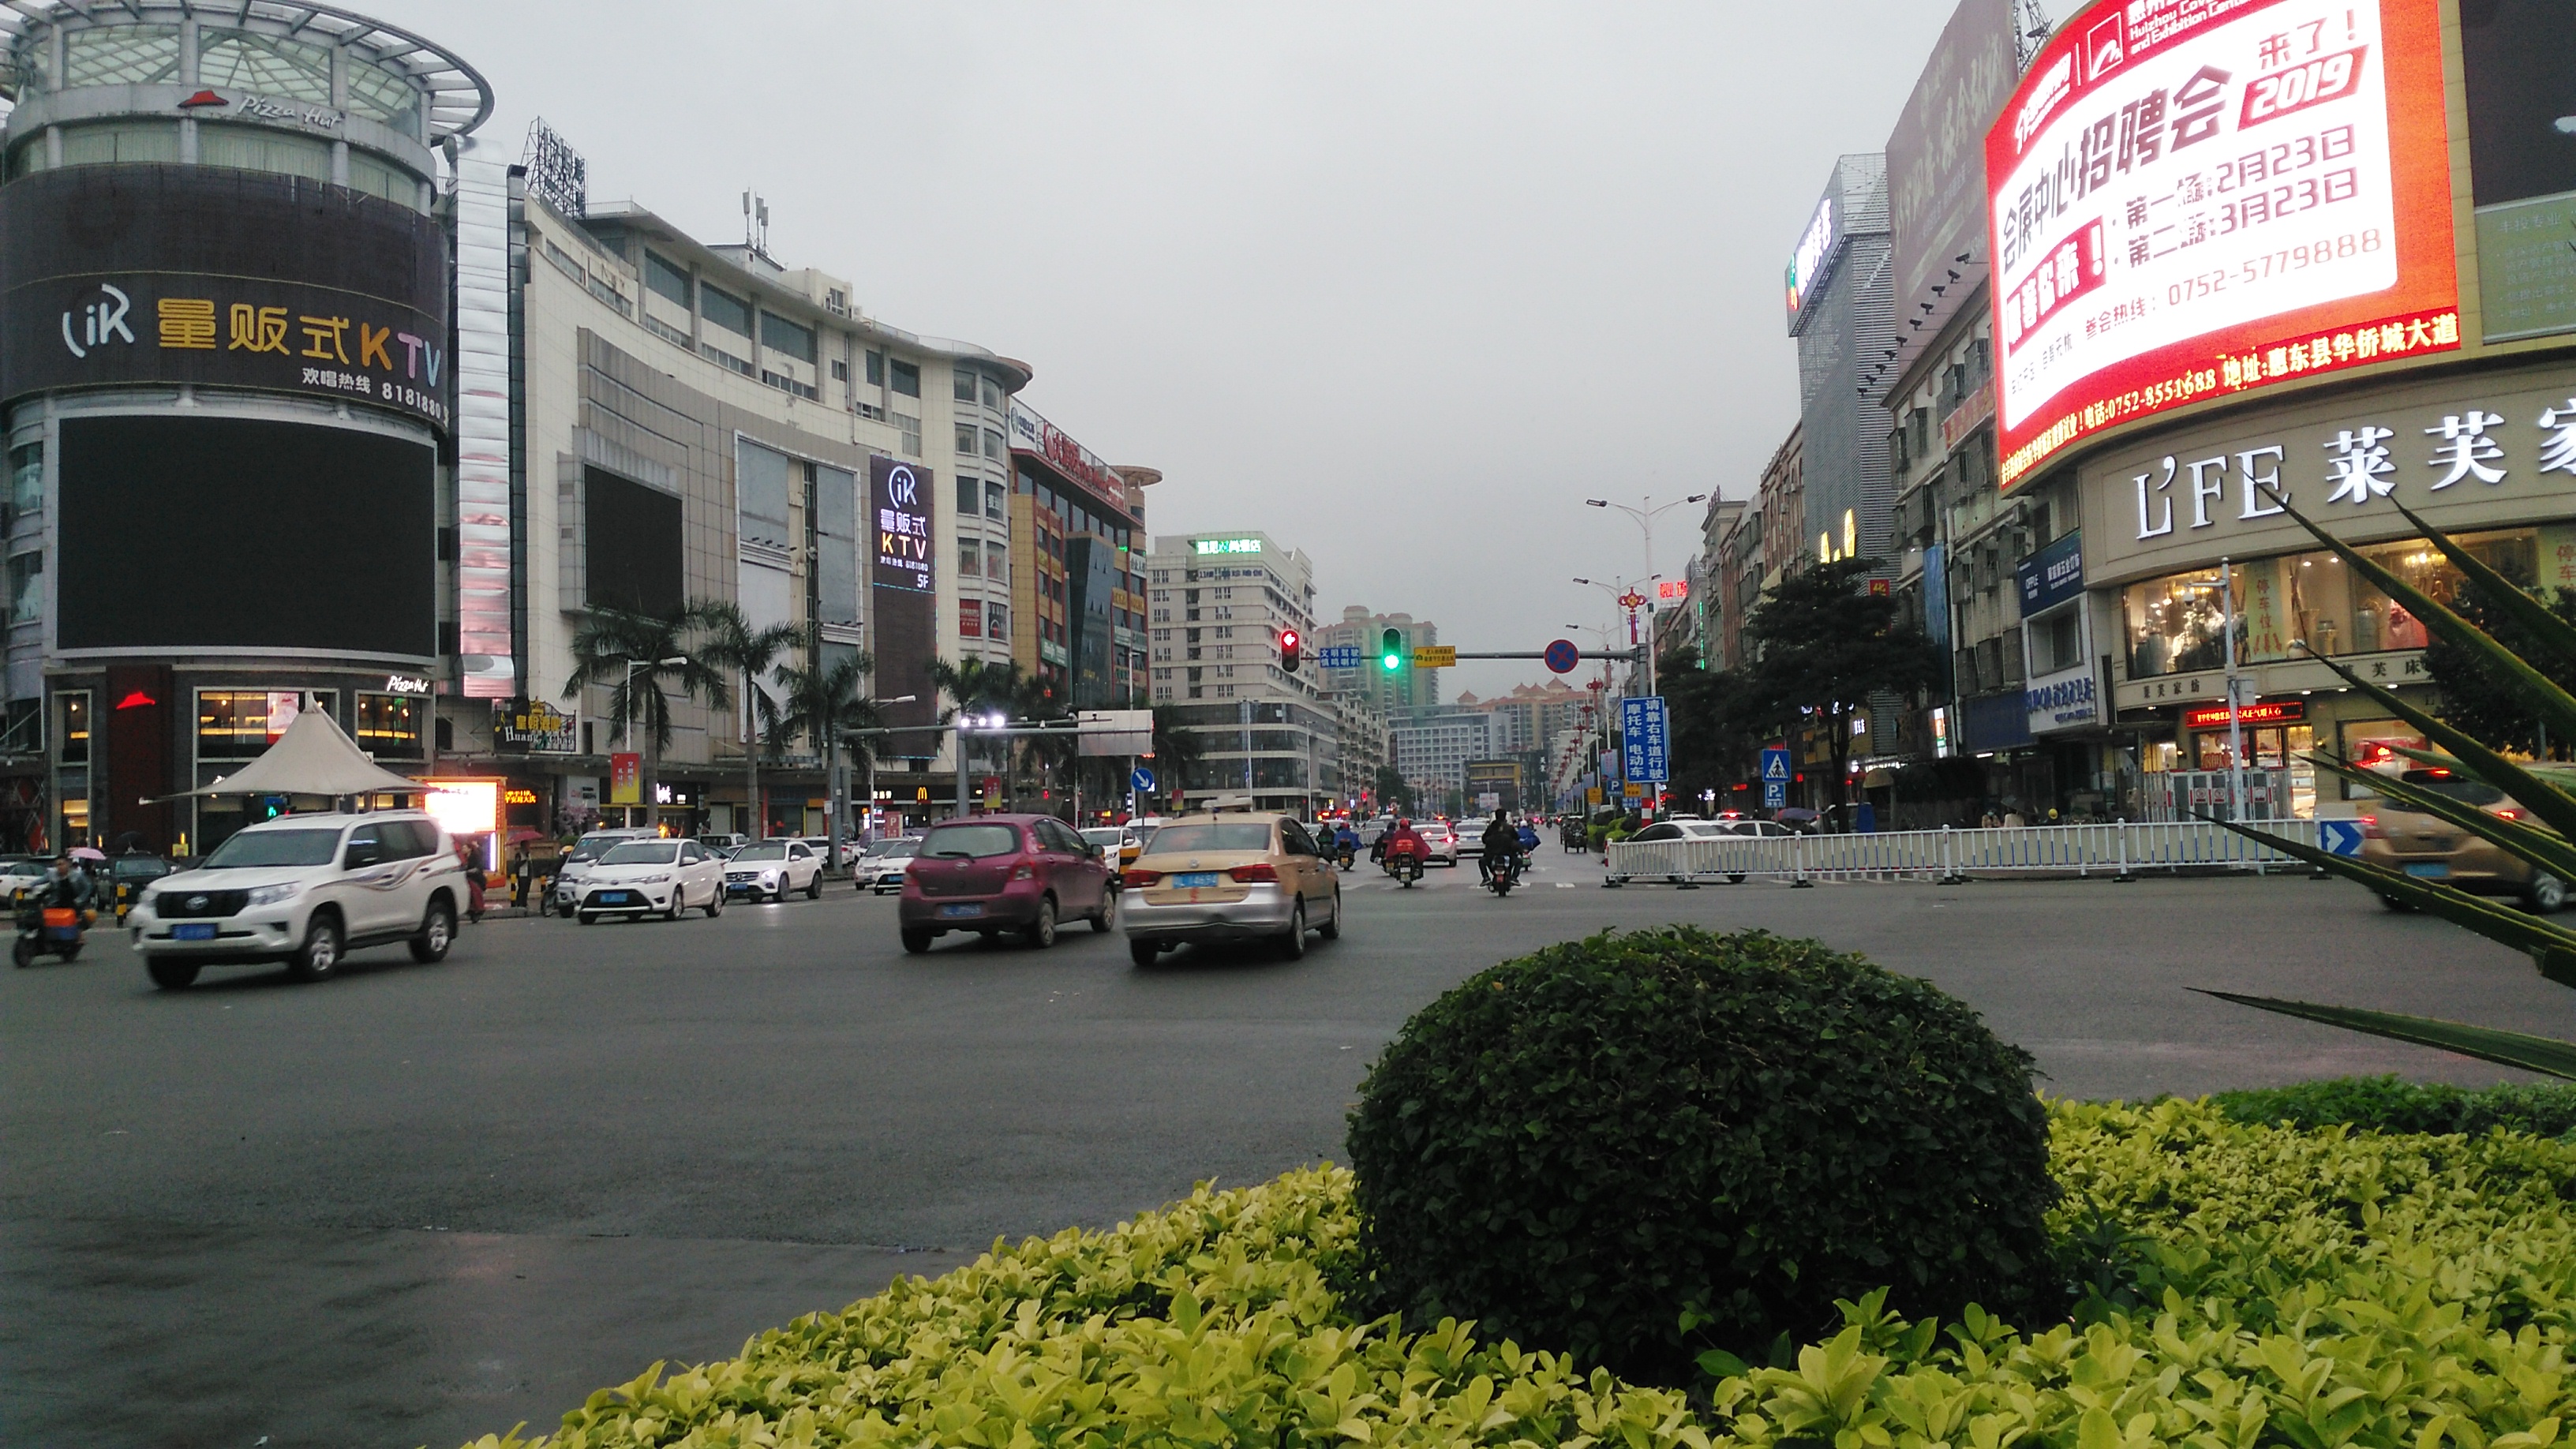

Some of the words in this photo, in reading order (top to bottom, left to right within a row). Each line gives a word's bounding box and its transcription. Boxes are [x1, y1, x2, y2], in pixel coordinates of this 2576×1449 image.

[2252, 53, 2353, 119] 2019
[238, 95, 295, 117] Pizza
[305, 107, 342, 129] Hut
[2004, 64, 2233, 275] 会展中心招聘会
[2168, 228, 2381, 306] 0752-5779888
[2222, 312, 2458, 388] 地址:惠东县华侨城大道
[301, 367, 371, 394] 欢唱热线
[382, 382, 440, 420] 8181880
[880, 508, 927, 537] 量贩式
[882, 531, 927, 560] KTV
[917, 574, 929, 589] 5F
[1320, 648, 1360, 658] 文明驾驶
[387, 675, 414, 692] Pizza
[1627, 704, 1642, 737] 摩托车
[1645, 699, 1664, 780] 请靠右车道行驶
[1629, 744, 1644, 777] 电动车
[1612, 781, 1619, 790] P
[1769, 785, 1779, 797] P
